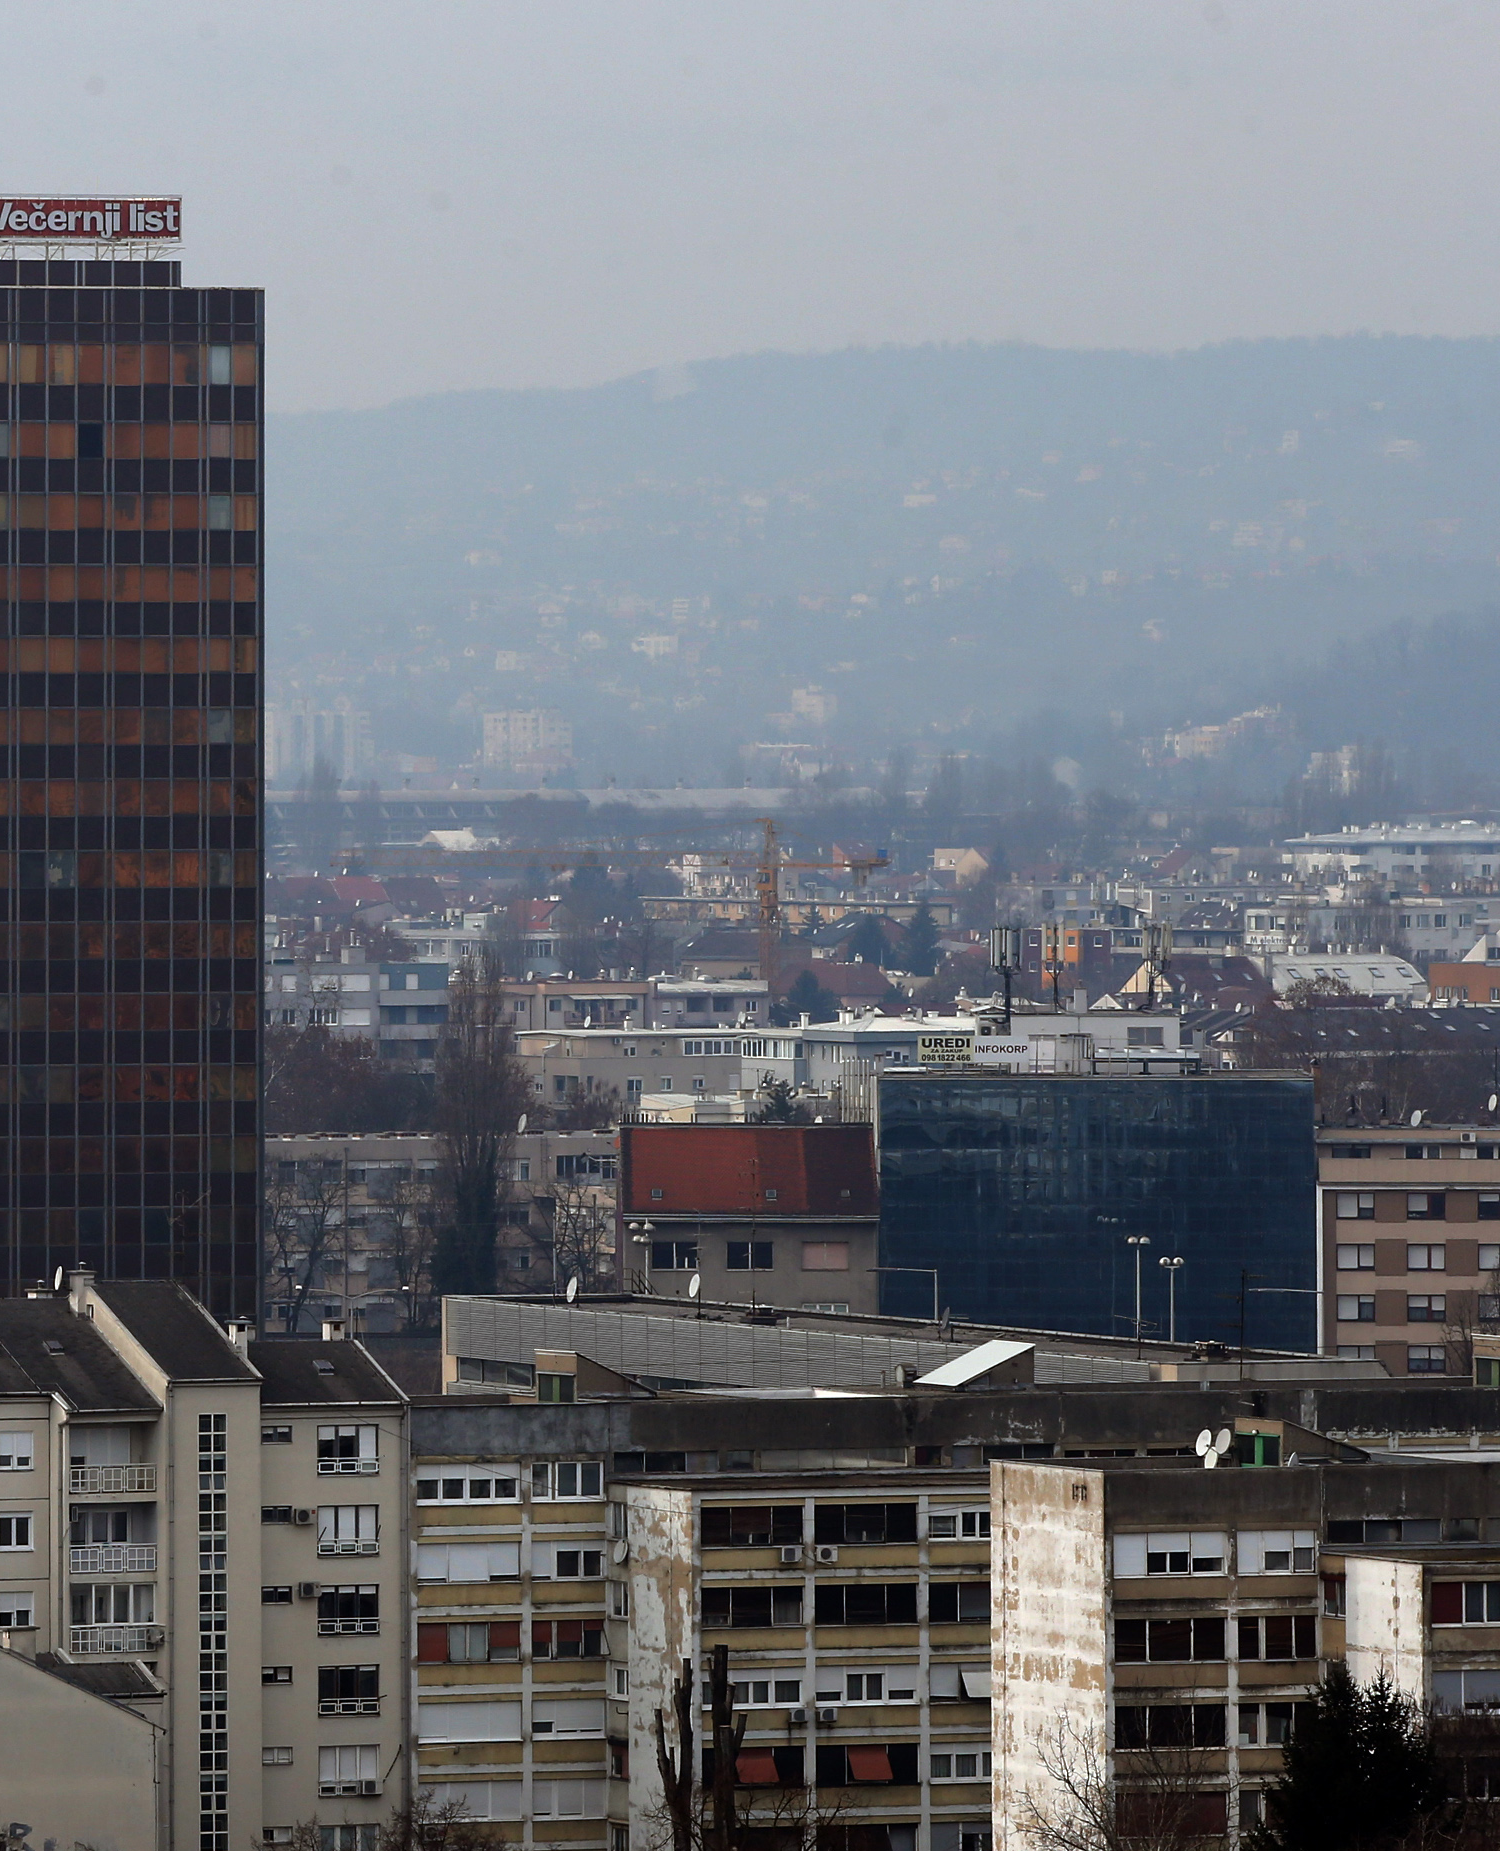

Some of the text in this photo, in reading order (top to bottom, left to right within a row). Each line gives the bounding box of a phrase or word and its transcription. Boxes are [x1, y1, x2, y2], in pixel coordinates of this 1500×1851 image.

[129, 203, 179, 232] list
[921, 1038, 970, 1048] UREDI
[974, 1045, 1028, 1053] INFOKORP
